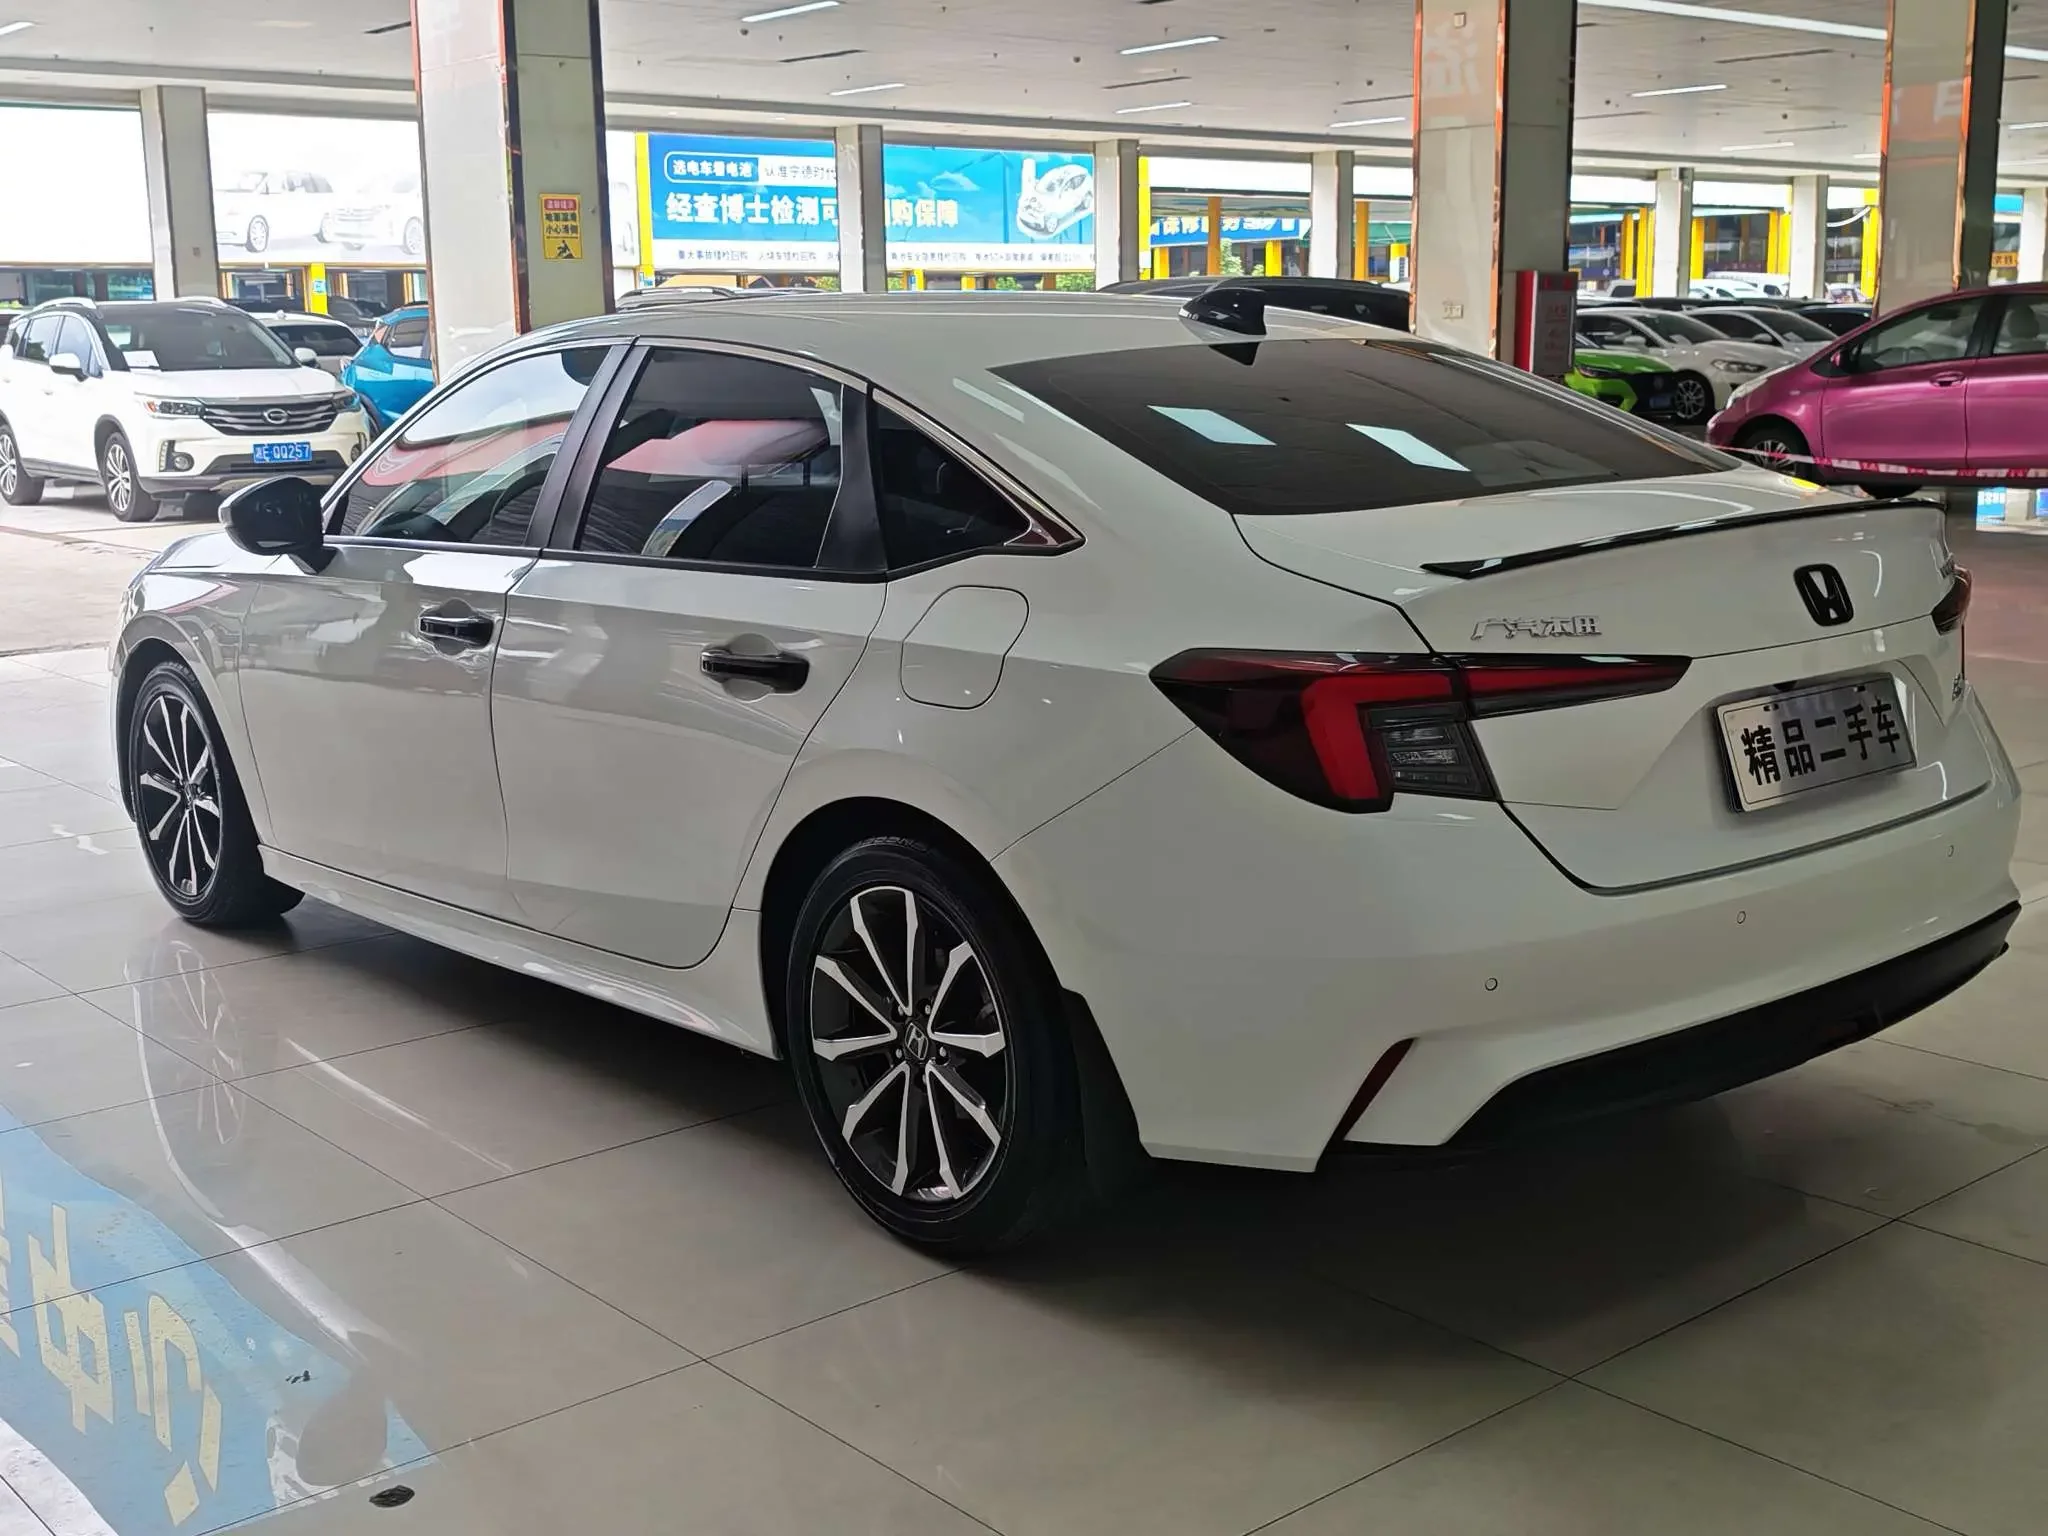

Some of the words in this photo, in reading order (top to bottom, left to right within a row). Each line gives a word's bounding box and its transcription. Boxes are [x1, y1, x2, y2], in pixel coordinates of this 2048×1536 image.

[1470, 615, 1602, 641] 广汽本田
[1740, 694, 1901, 787] 精品二手车
